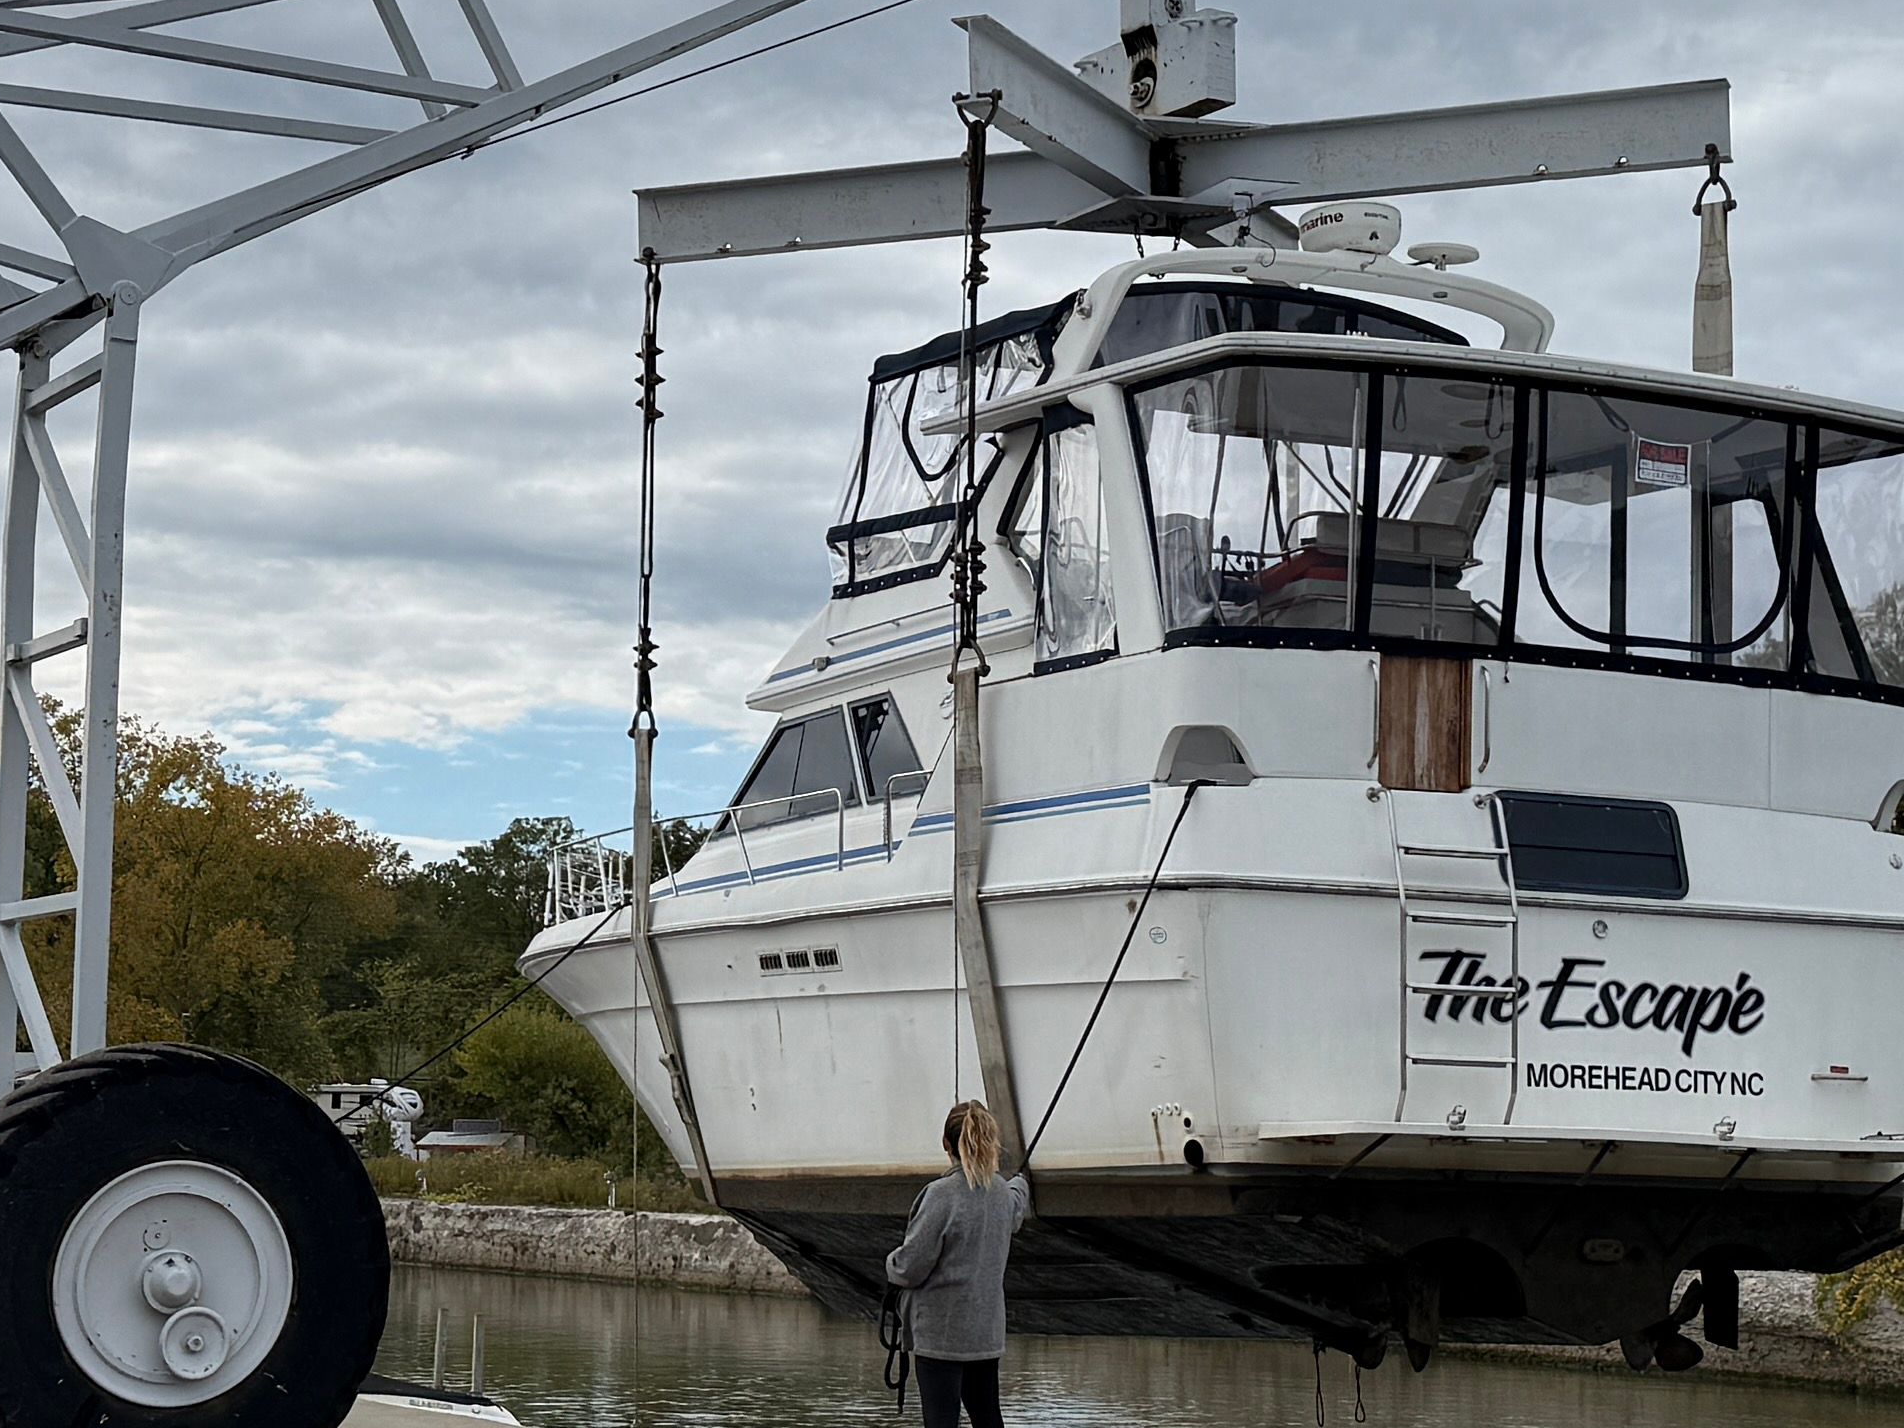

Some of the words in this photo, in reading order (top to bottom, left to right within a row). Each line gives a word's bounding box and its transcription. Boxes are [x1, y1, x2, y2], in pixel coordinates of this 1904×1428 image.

[1418, 949, 1530, 1024] The
[1526, 1062, 1670, 1092] MOREHEAD
[1674, 1067, 1728, 1094] CITY
[1730, 1072, 1764, 1096] NC
